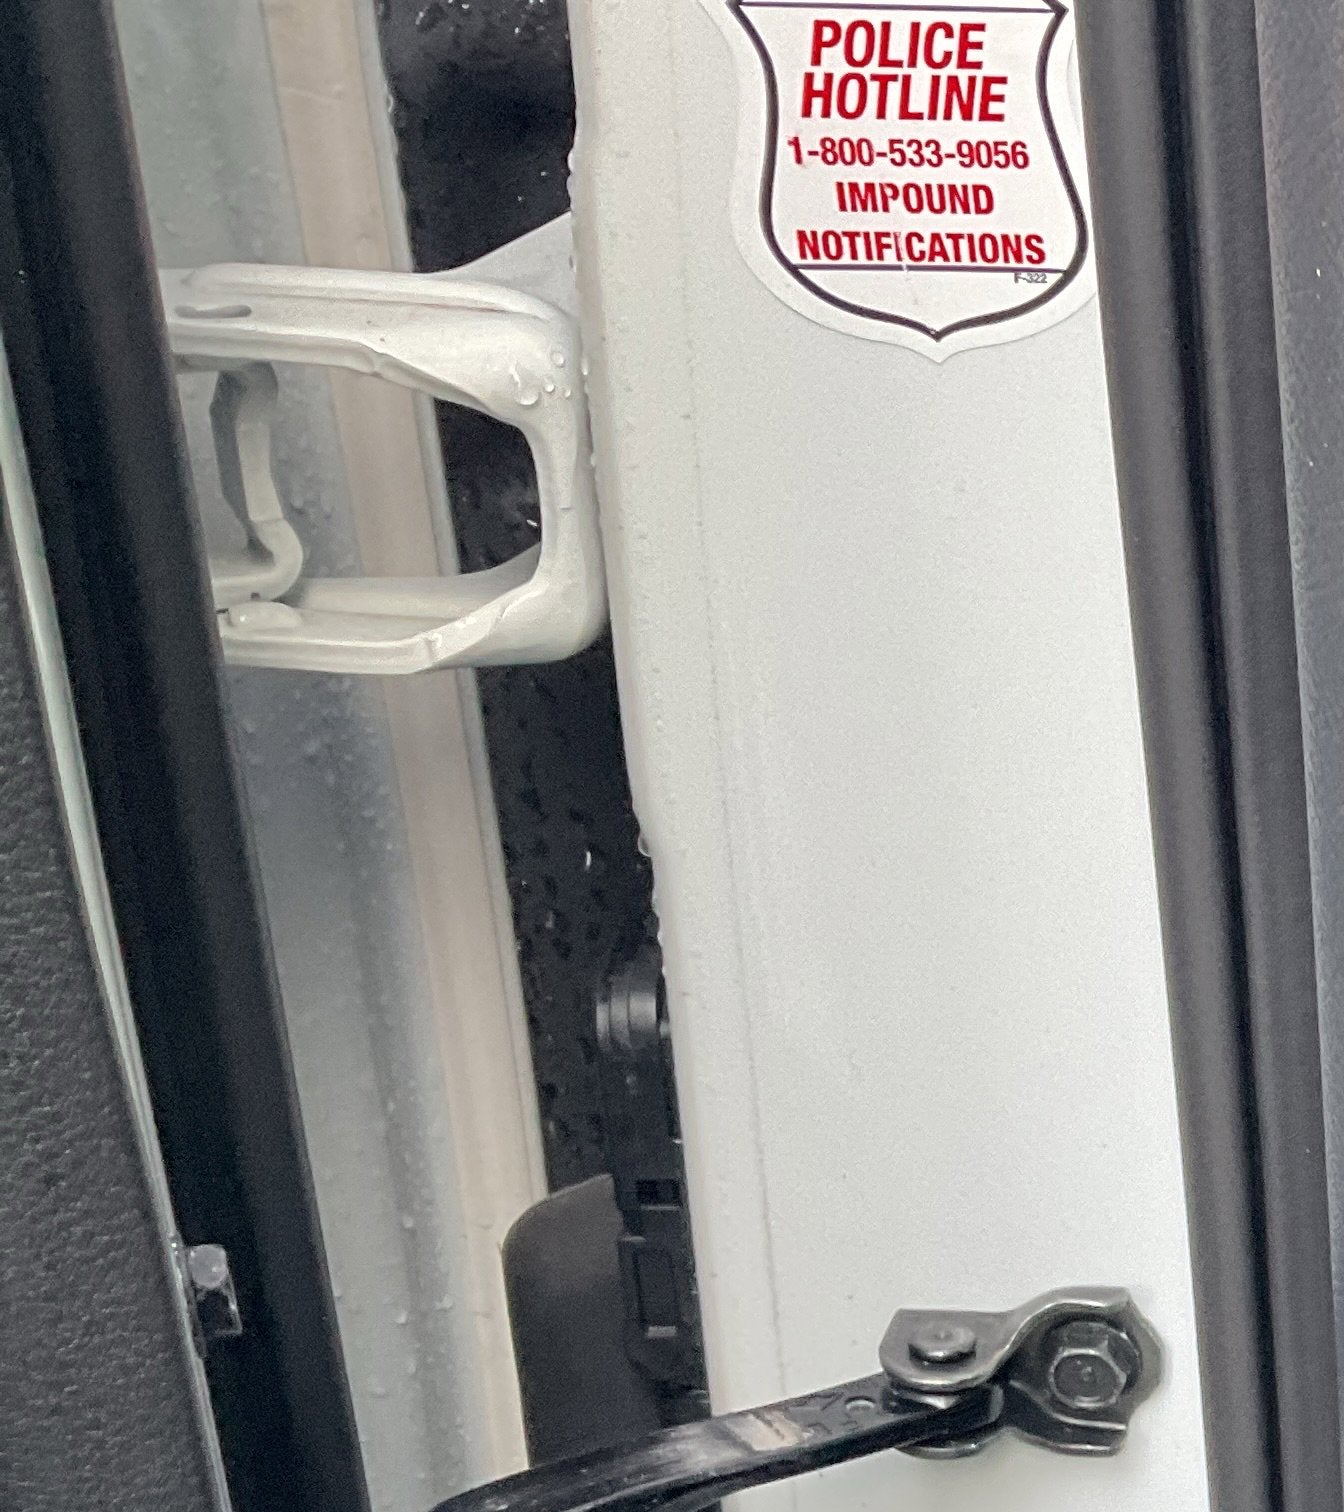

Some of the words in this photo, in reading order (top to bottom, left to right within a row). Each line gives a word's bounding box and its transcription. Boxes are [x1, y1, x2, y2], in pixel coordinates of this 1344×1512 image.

[810, 19, 986, 70] POLICE
[801, 72, 1008, 122] HOTLINE
[788, 136, 1029, 170] 1-800-533-9056
[835, 181, 994, 215] IMPOUND
[796, 229, 1046, 265] NOTIFICATIONS
